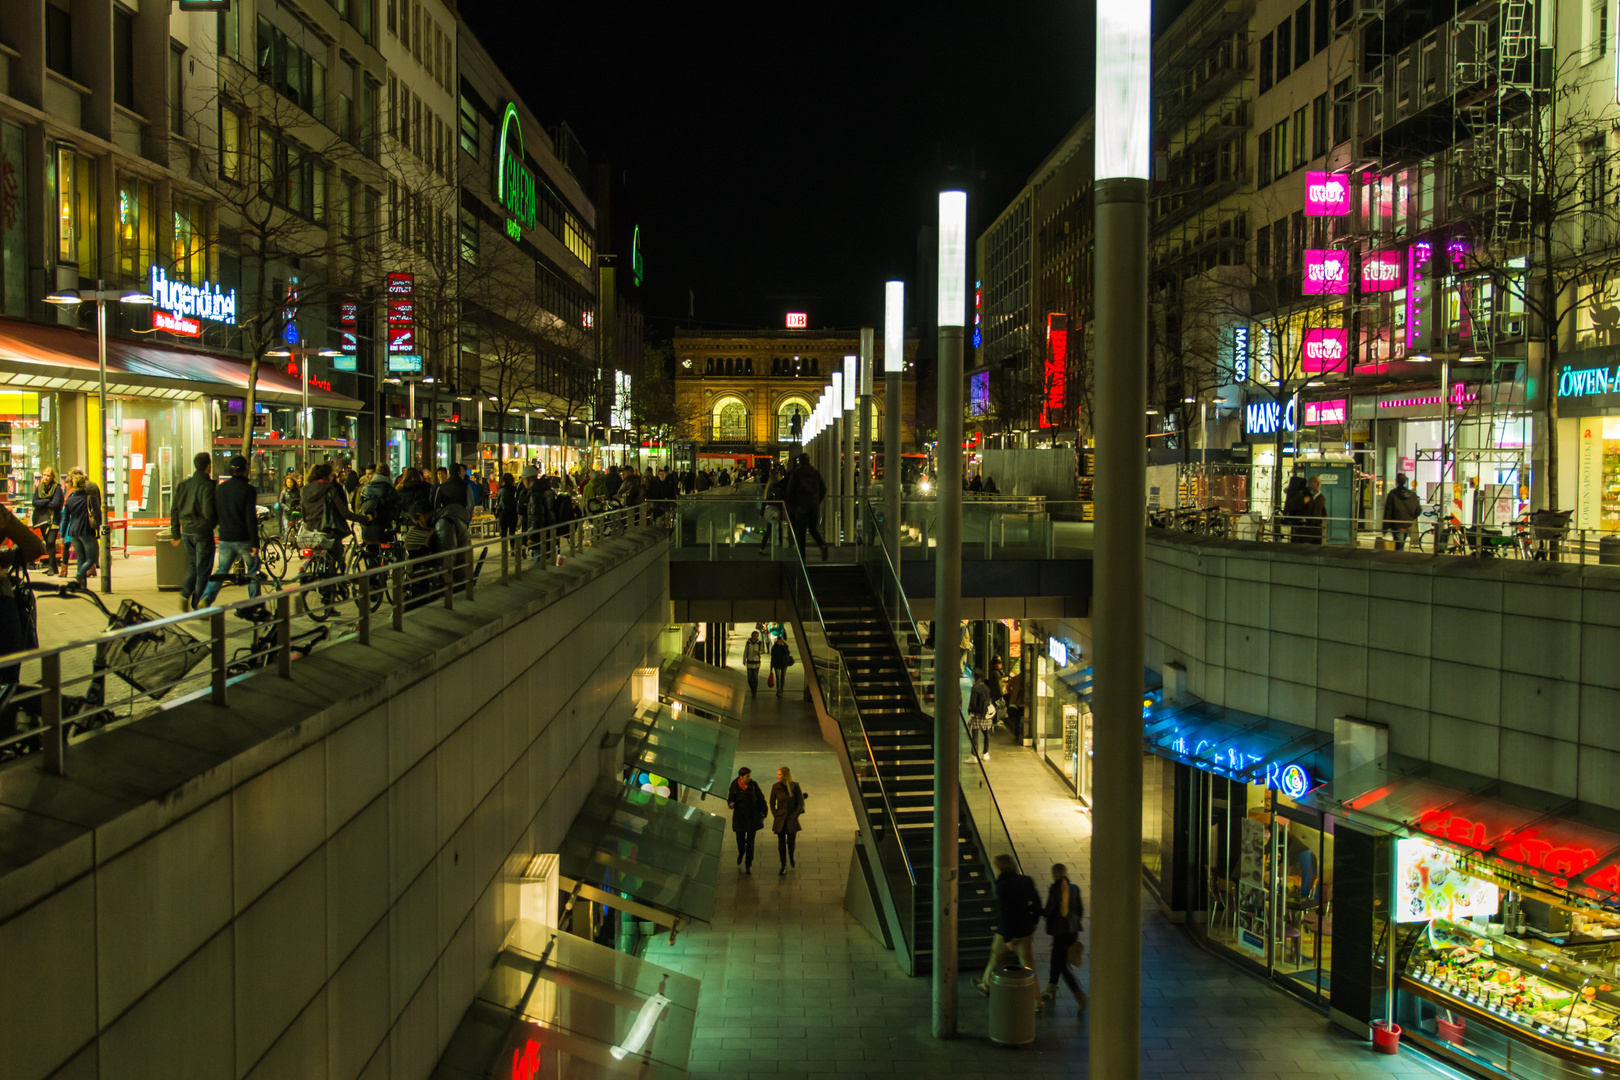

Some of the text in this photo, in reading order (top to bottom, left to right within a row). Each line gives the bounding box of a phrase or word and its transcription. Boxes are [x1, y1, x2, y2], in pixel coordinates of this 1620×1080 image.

[506, 153, 537, 232] GALERIA
[151, 265, 235, 324] Hugendubel
[789, 316, 805, 325] DB
[1235, 329, 1247, 382] MANGO
[1557, 365, 1620, 397] ÖWEN-A
